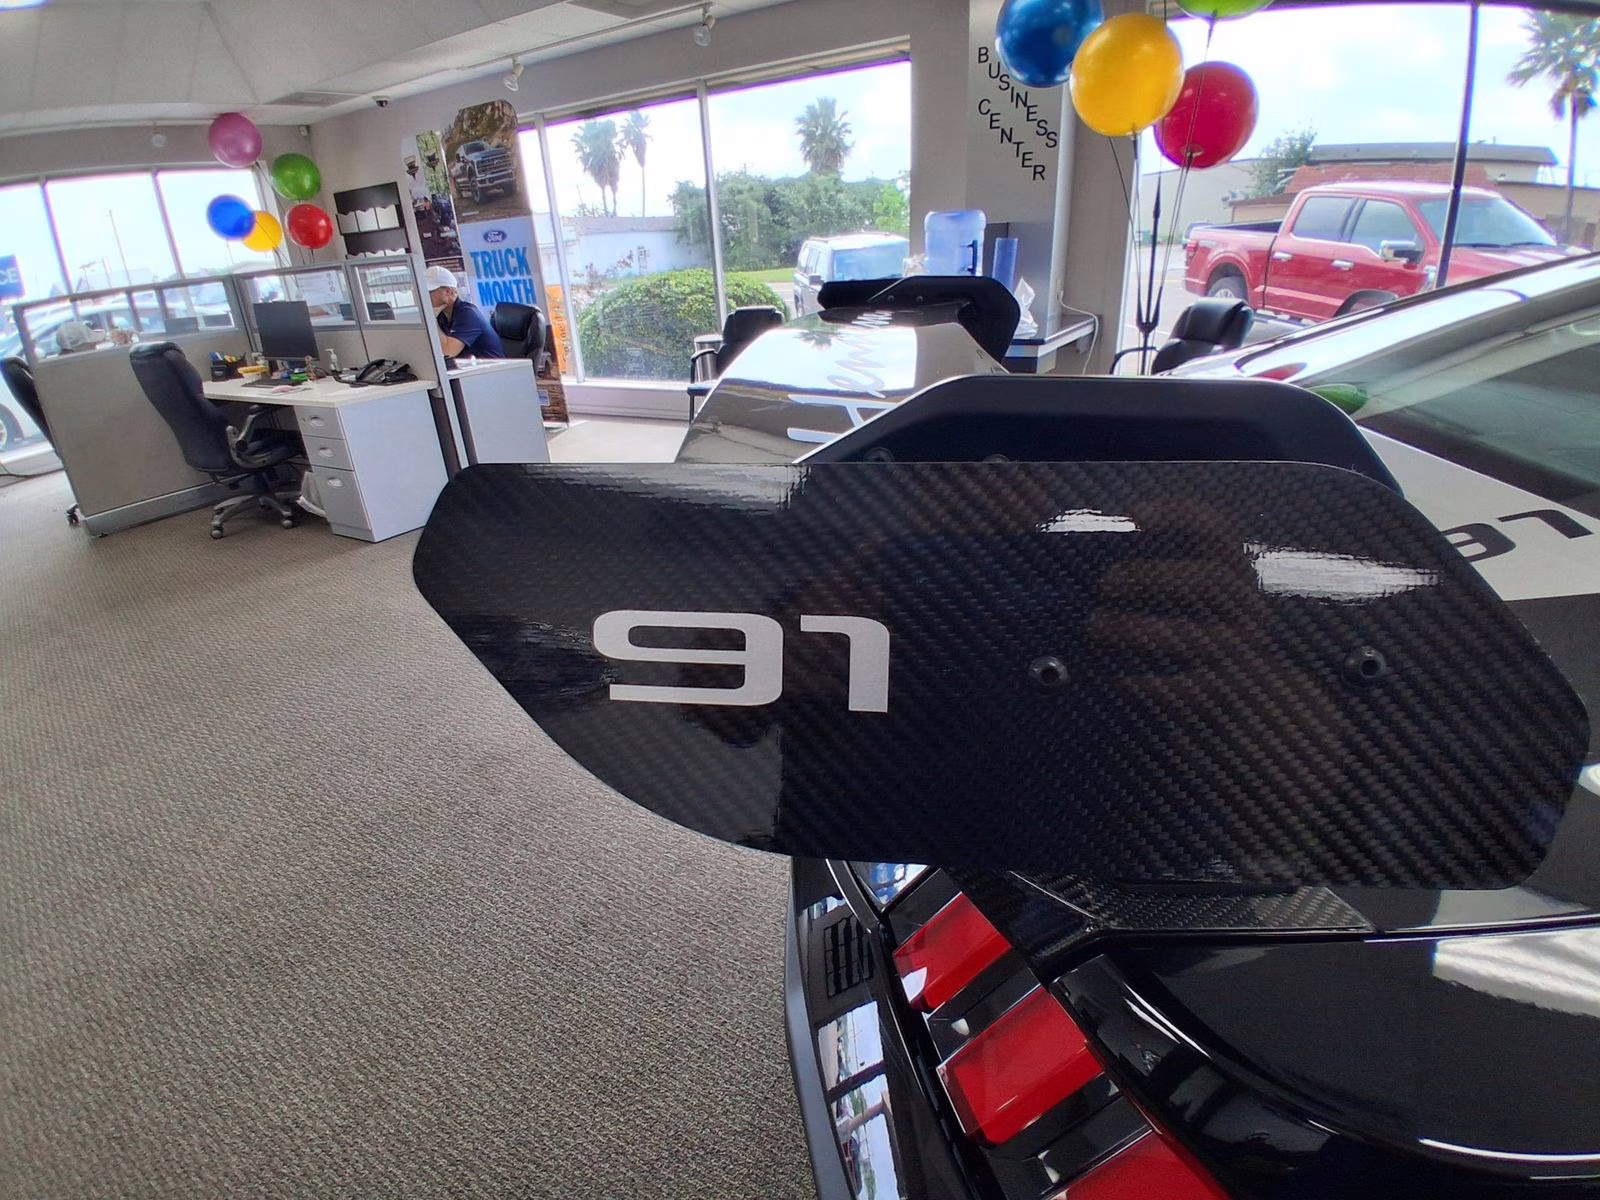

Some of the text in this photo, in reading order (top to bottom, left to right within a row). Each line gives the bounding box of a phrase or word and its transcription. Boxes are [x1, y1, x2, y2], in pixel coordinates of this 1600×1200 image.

[978, 46, 1058, 148] BUSINESS
[978, 99, 1046, 181] CENTER
[470, 247, 532, 279] TRUCK
[477, 278, 537, 307] MONTH
[593, 609, 890, 713] 91
